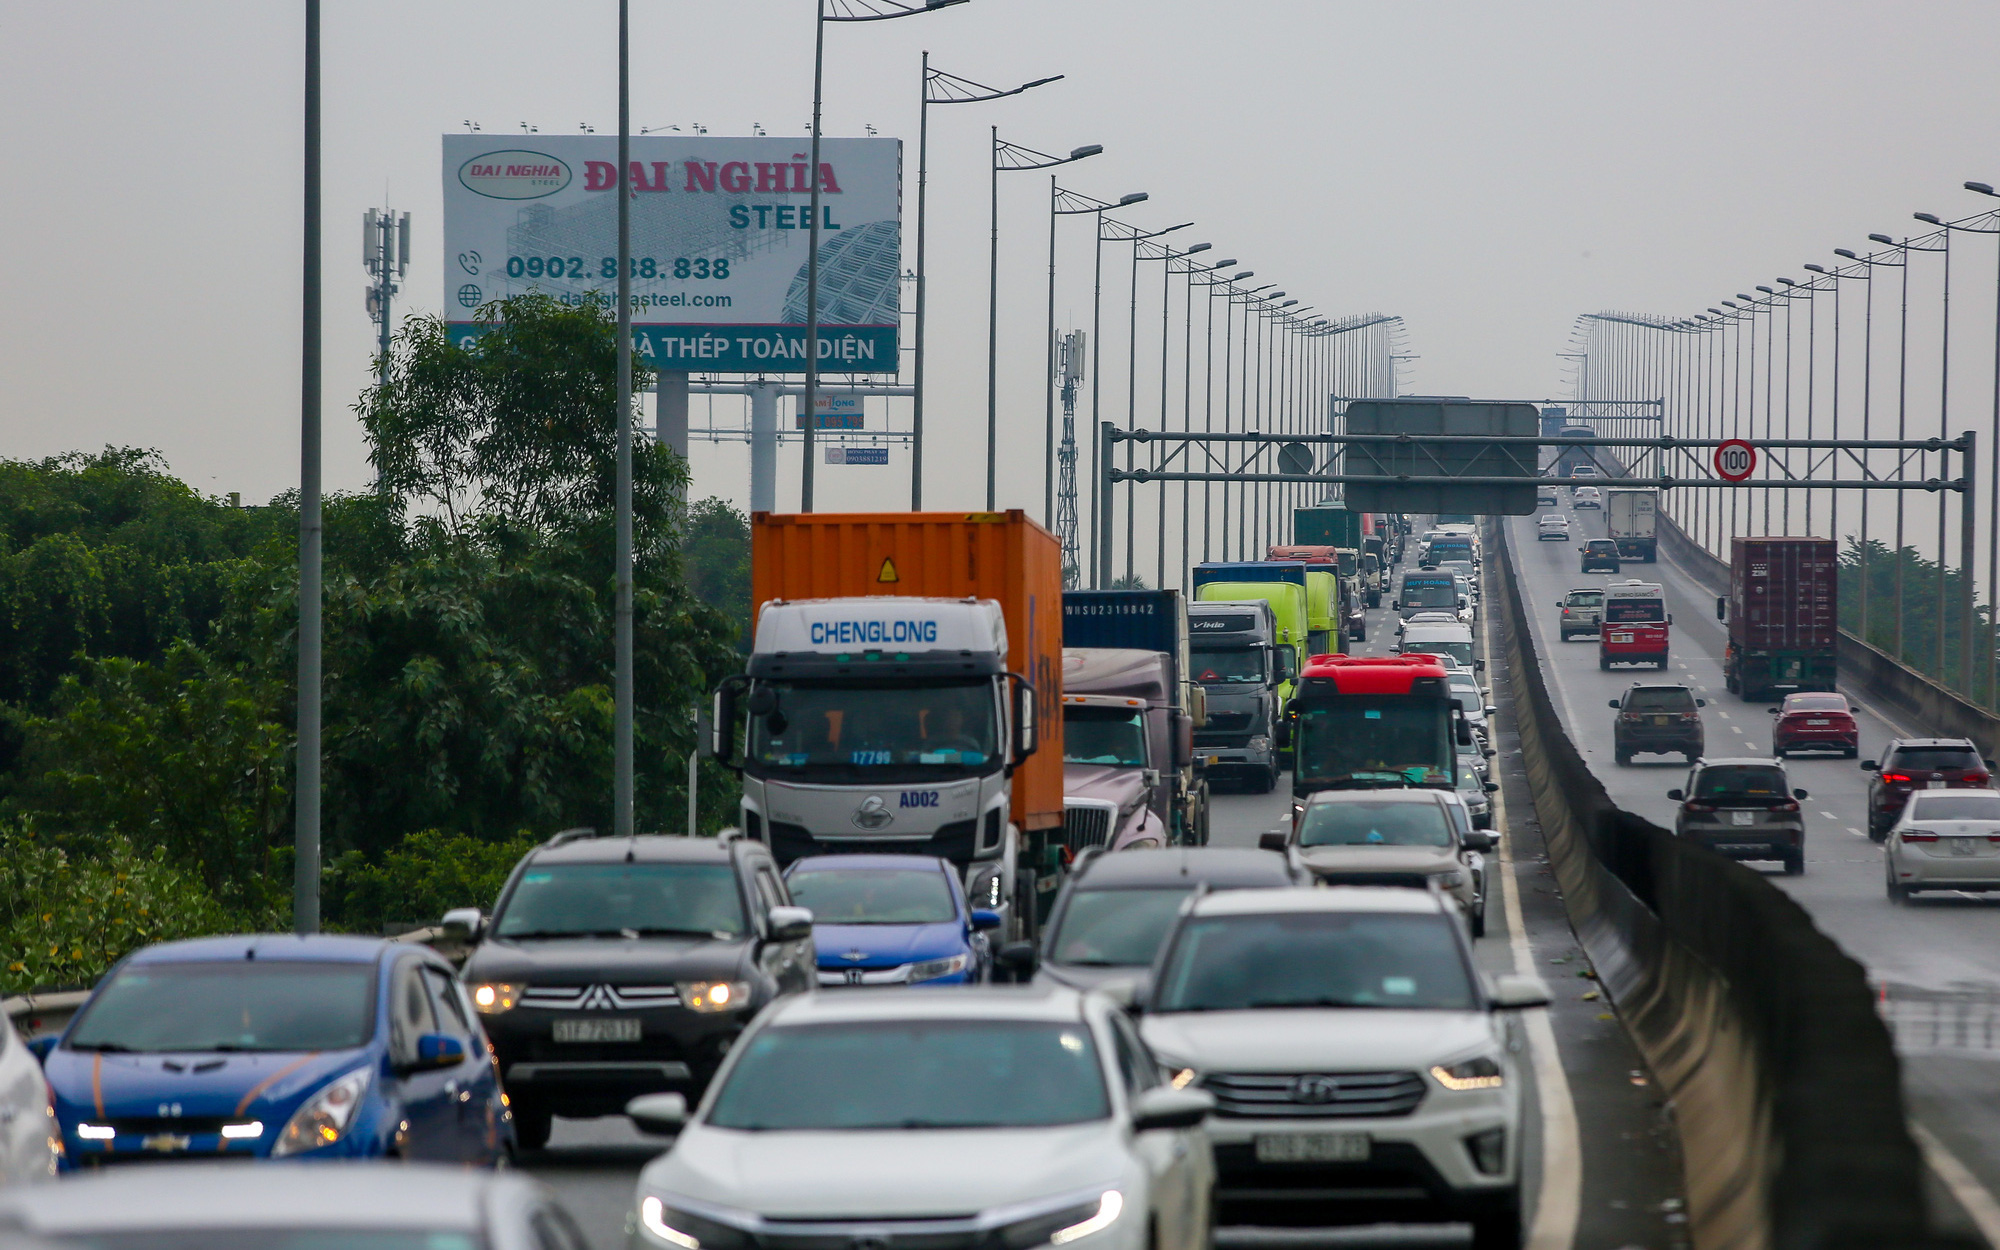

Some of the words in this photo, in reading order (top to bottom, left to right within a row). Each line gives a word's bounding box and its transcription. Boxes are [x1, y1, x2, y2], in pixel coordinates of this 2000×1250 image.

[584, 161, 669, 198] ĐẠI
[684, 152, 842, 193] NGHĨA
[729, 204, 841, 230] STEEL
[673, 257, 730, 280] 838
[661, 332, 730, 359] THÉP
[736, 333, 807, 359] TOÀN
[816, 333, 875, 364] DIỆN
[1723, 451, 1748, 470] 100
[811, 621, 937, 644] CHENGLONG
[899, 791, 939, 808] AD02
